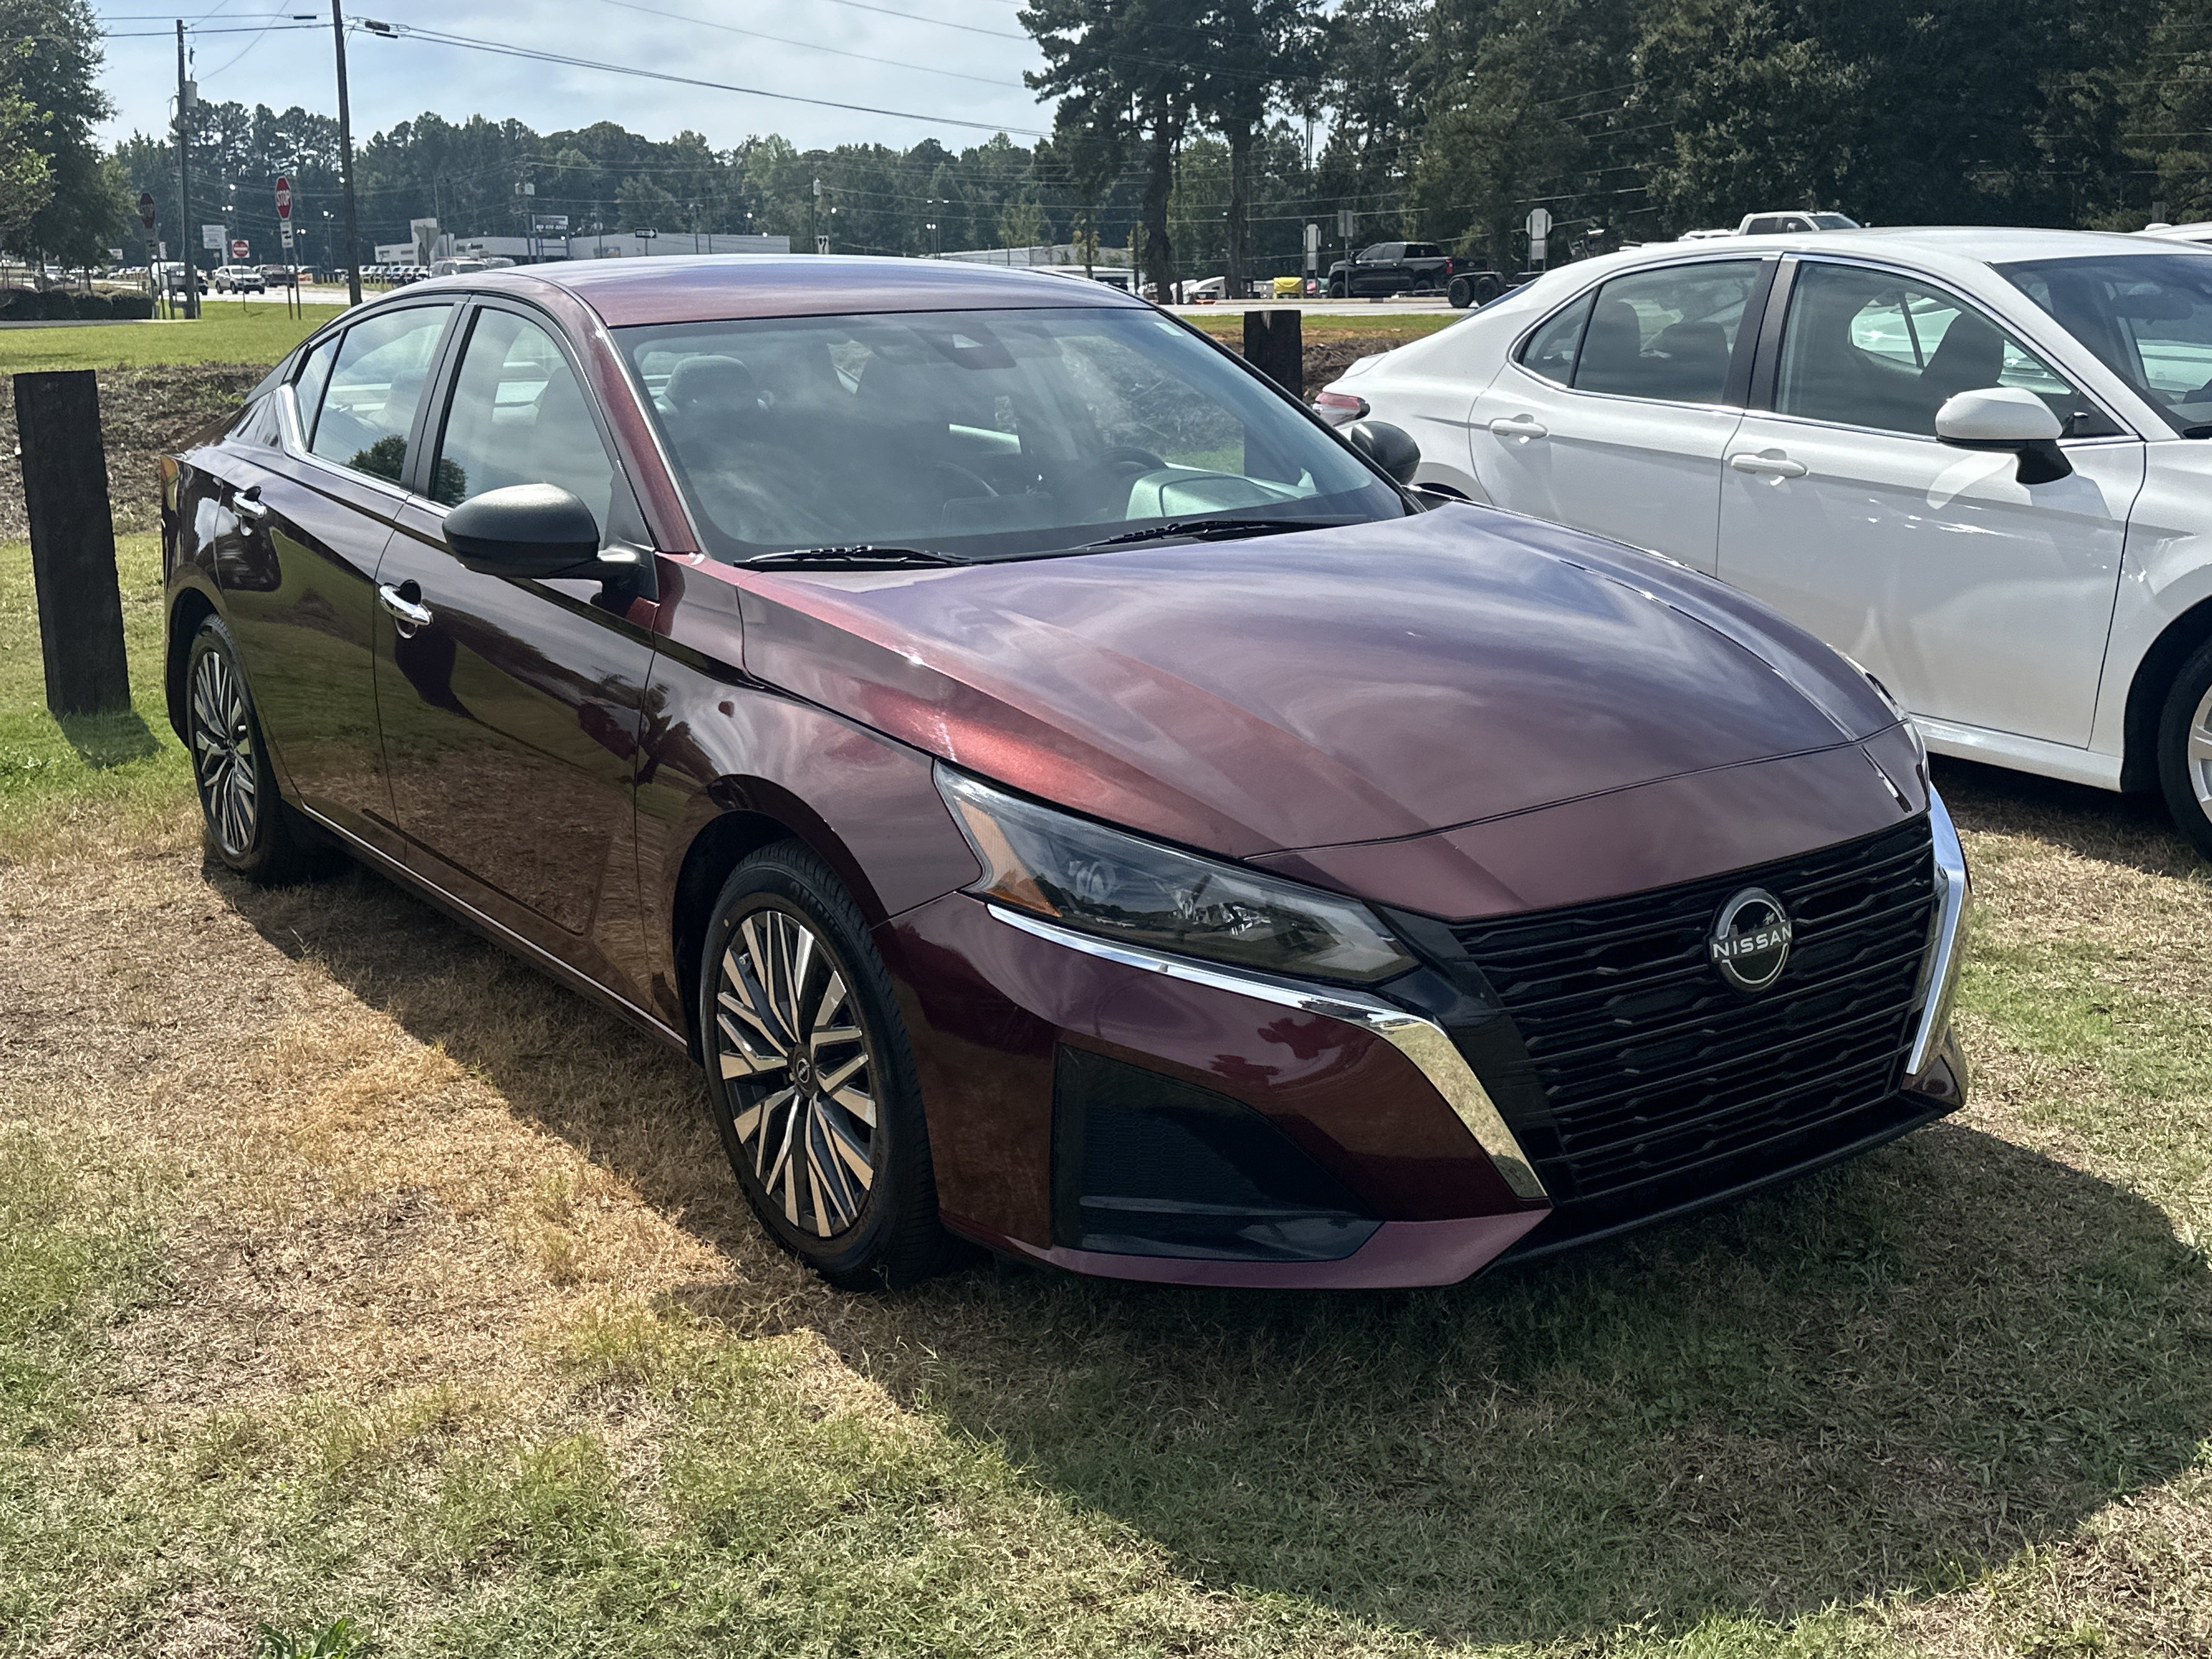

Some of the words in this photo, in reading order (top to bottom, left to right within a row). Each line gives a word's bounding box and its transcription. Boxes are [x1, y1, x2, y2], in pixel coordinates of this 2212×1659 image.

[276, 189, 290, 206] STOP
[140, 203, 154, 218] STOP
[1712, 923, 1792, 958] NISSAN
